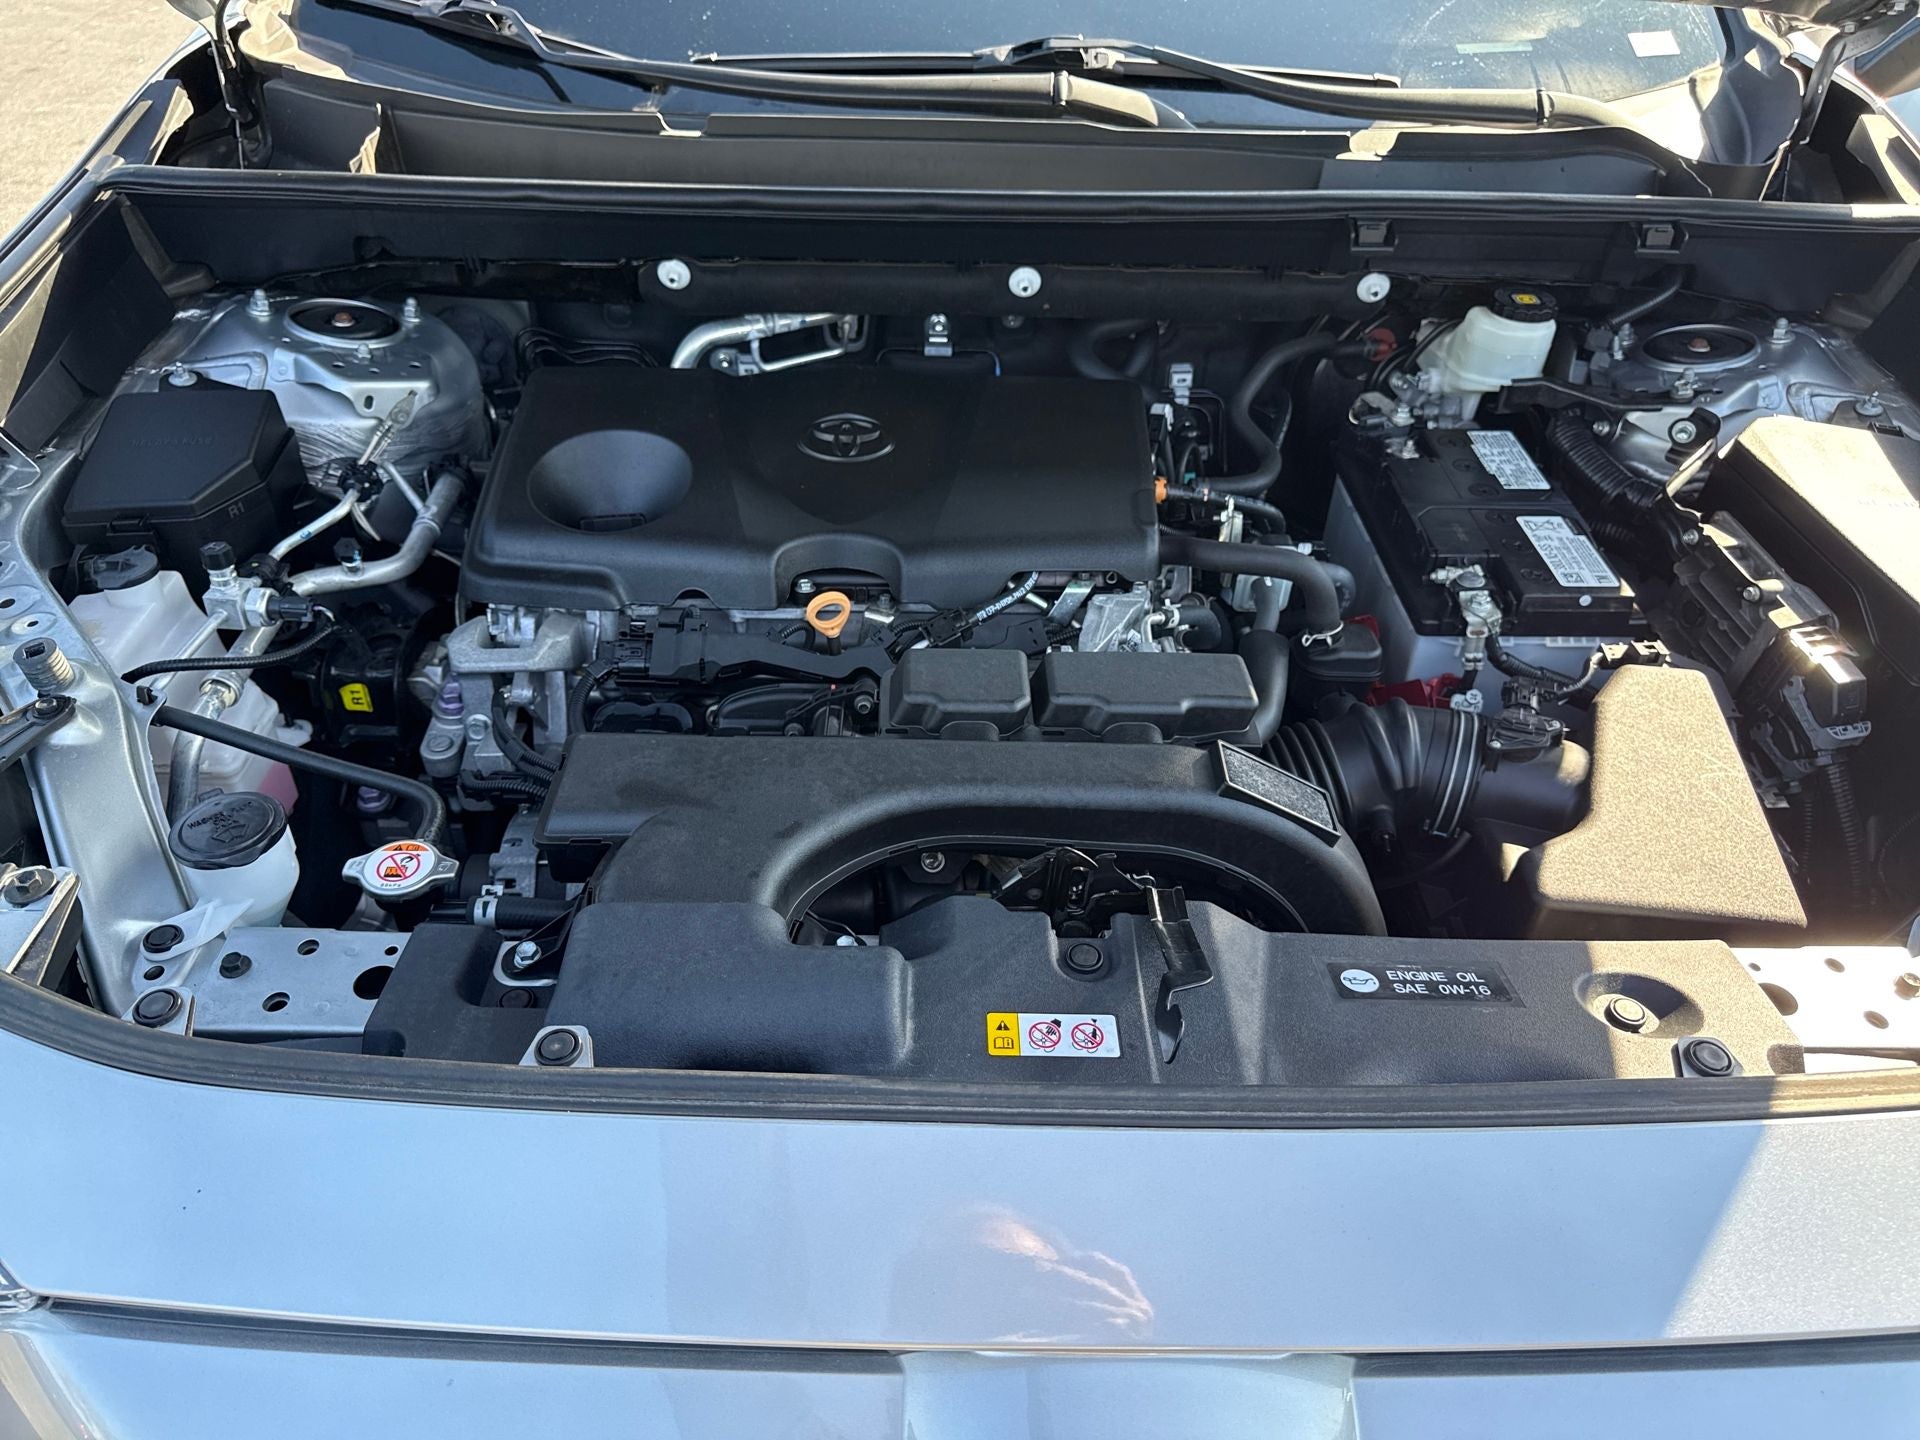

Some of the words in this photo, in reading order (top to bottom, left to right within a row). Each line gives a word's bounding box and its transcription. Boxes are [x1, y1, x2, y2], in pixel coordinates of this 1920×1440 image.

[229, 501, 245, 519] R1
[350, 690, 364, 705] R1
[1386, 970, 1448, 982] ENGINE
[1456, 972, 1485, 983] OIL
[1393, 983, 1429, 994] SAE
[1438, 984, 1491, 996] 0W-16
